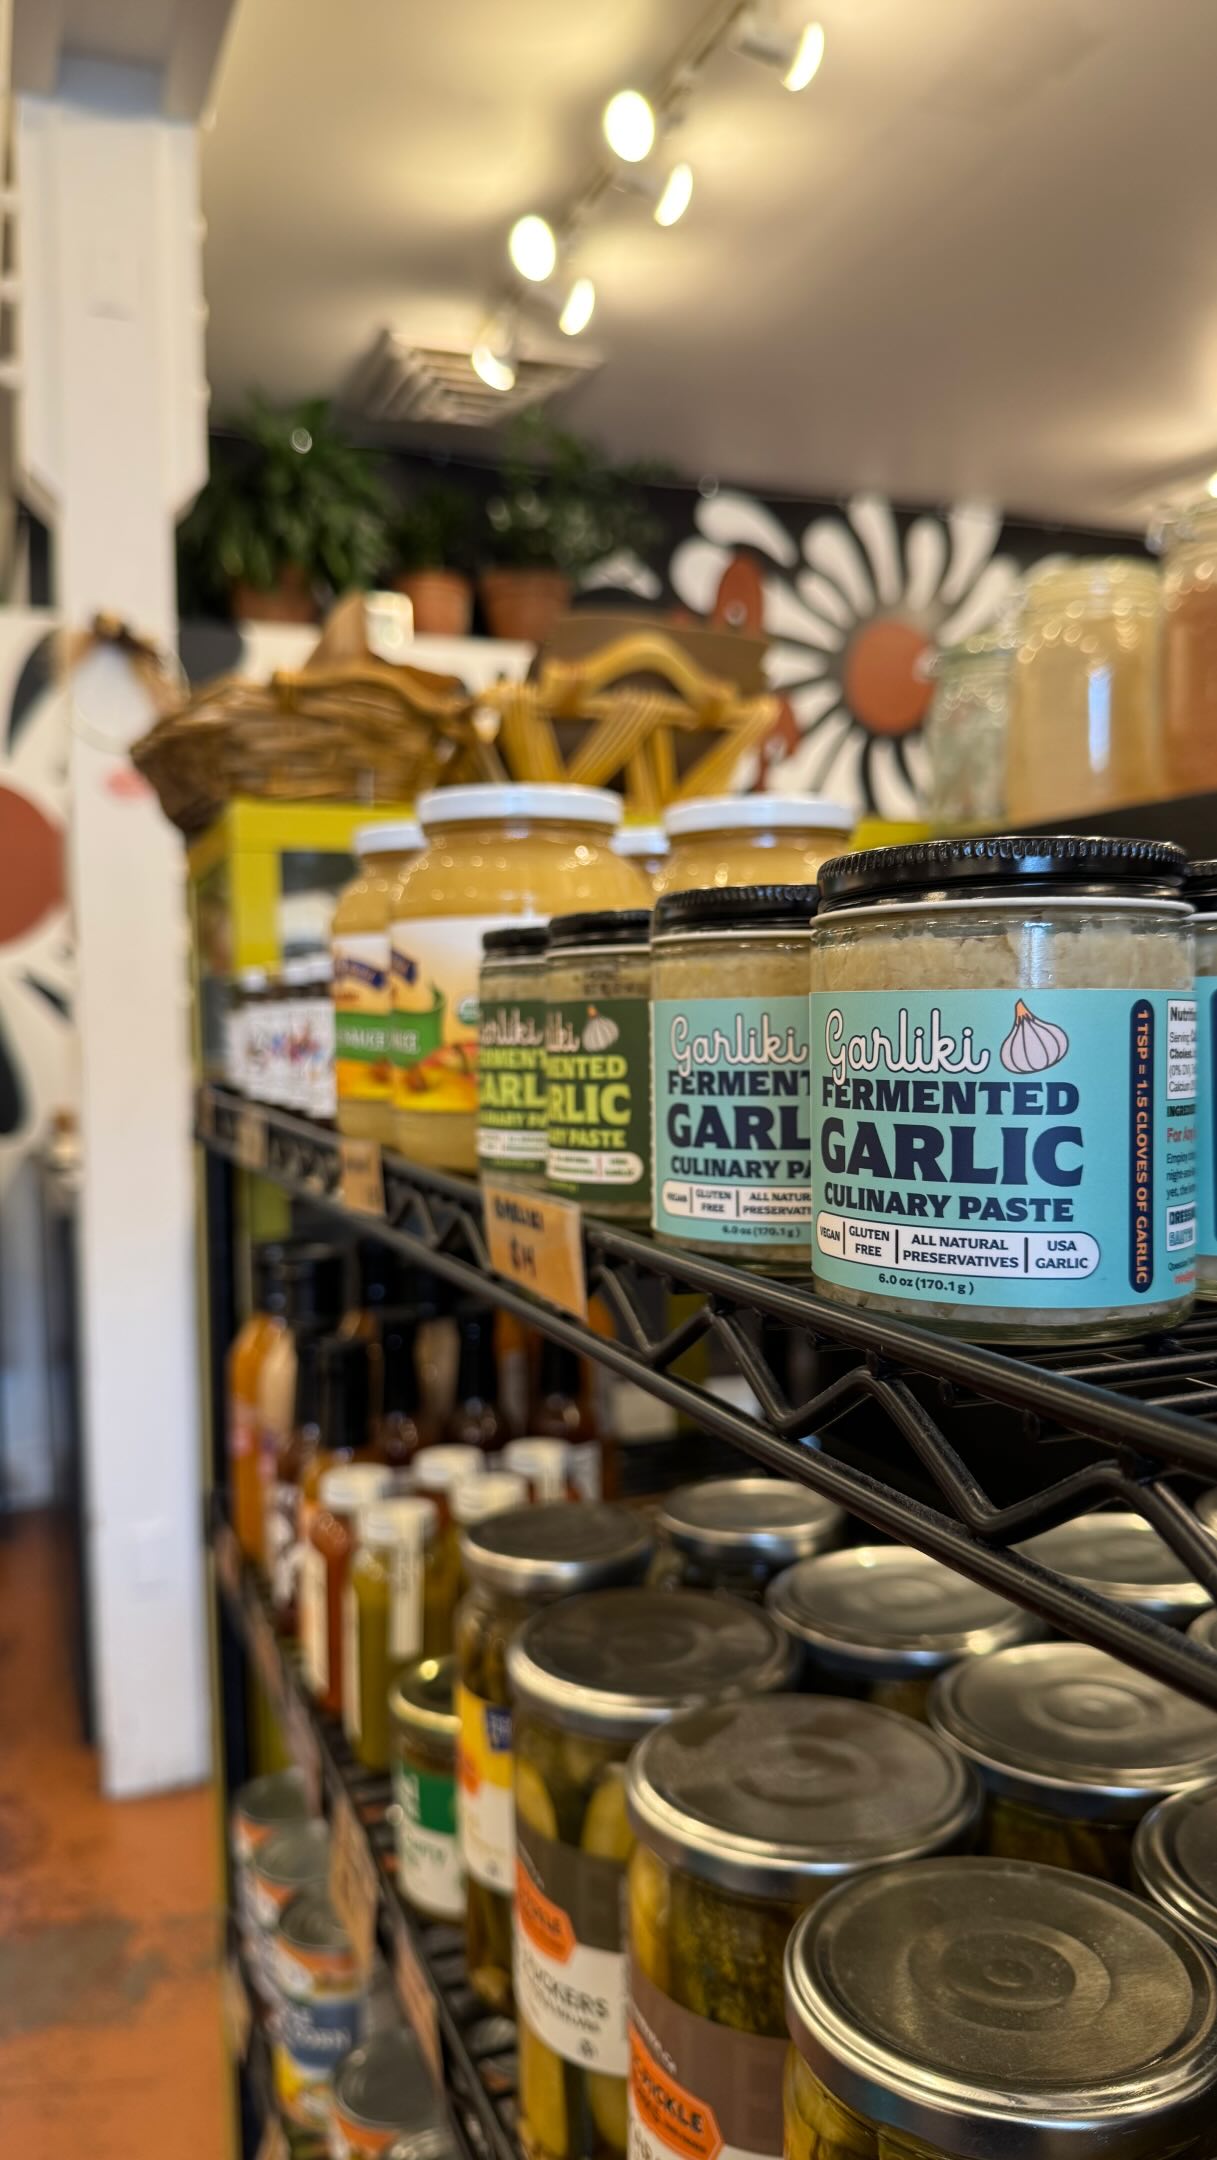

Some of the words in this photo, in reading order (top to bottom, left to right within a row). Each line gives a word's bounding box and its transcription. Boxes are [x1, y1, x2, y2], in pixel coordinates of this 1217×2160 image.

[1137, 1009, 1149, 1020] 1
[670, 1013, 809, 1078] Garliki
[825, 1008, 991, 1086] Garliki
[1136, 1023, 1149, 1060] TSP
[1138, 1064, 1146, 1075] =
[822, 1076, 1080, 1116] FERMENTED
[1136, 1080, 1149, 1108] 1.5
[667, 1102, 811, 1151] GARL
[820, 1117, 1084, 1187] GARLIC
[1135, 1111, 1148, 1184] CLOVES
[671, 1156, 780, 1179] CULINARY
[695, 1188, 732, 1201] GLUTEN
[749, 1191, 769, 1202] ALL
[824, 1182, 952, 1219] CULINARY
[959, 1197, 1074, 1222] PASTE
[1135, 1186, 1148, 1212] OF
[701, 1203, 725, 1213] FREE
[820, 1226, 841, 1242] VEGAN
[848, 1226, 890, 1242] GLUTEN
[911, 1233, 937, 1247] ALL
[939, 1237, 1009, 1251] NATURAL
[855, 1243, 882, 1257] FREE
[1046, 1240, 1077, 1252] USA
[1135, 1215, 1148, 1284] GARLIC
[903, 1250, 1019, 1269] PRESERVATIVES
[1035, 1256, 1089, 1270] GARLIC
[878, 1273, 898, 1286] 6.0
[900, 1277, 913, 1288] oz
